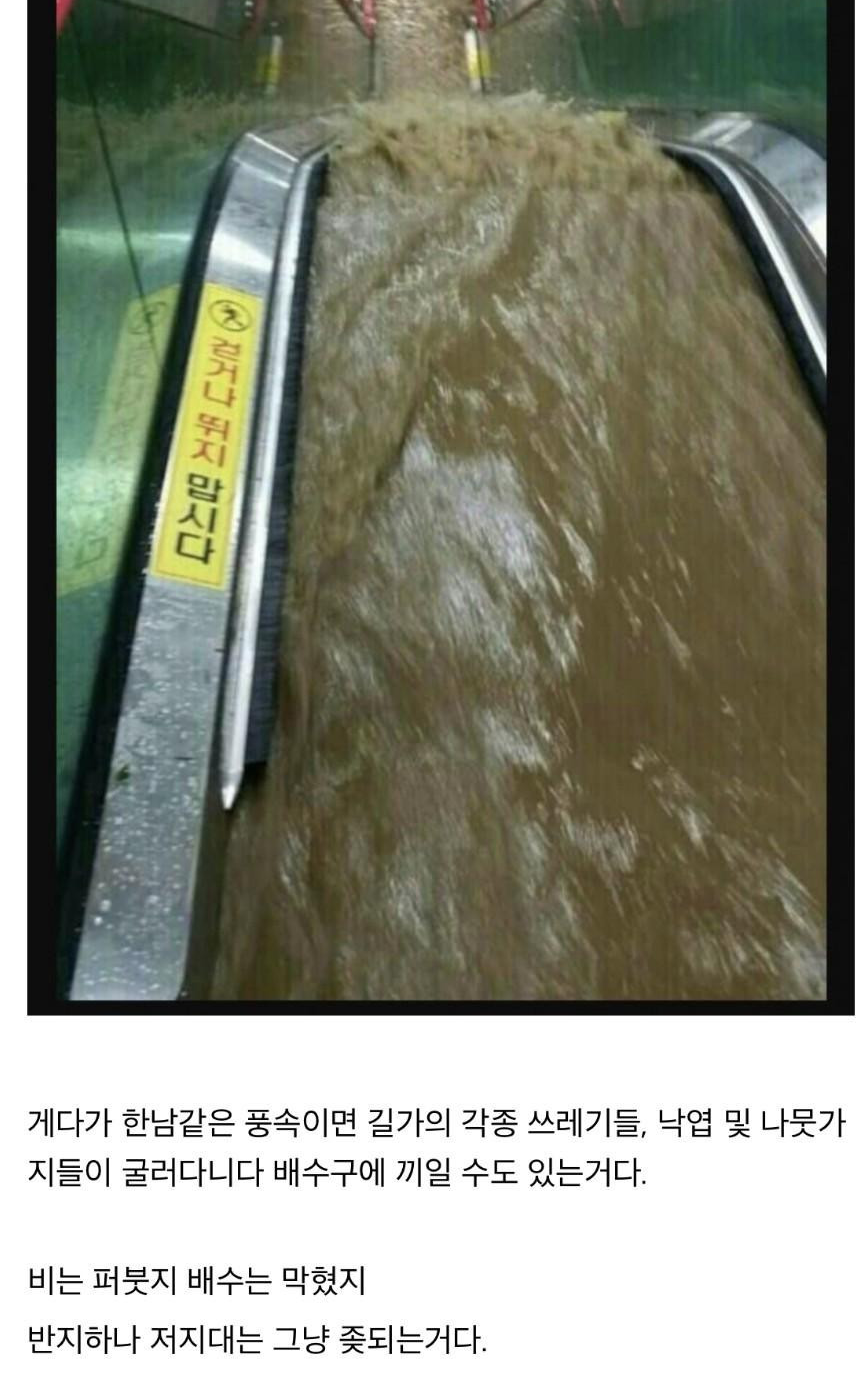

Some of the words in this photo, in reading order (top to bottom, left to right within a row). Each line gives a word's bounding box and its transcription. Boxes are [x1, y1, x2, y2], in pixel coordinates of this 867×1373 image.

[203, 336, 242, 408] 걷거나
[191, 412, 230, 469] 뛰지
[175, 472, 224, 566] 맙시다
